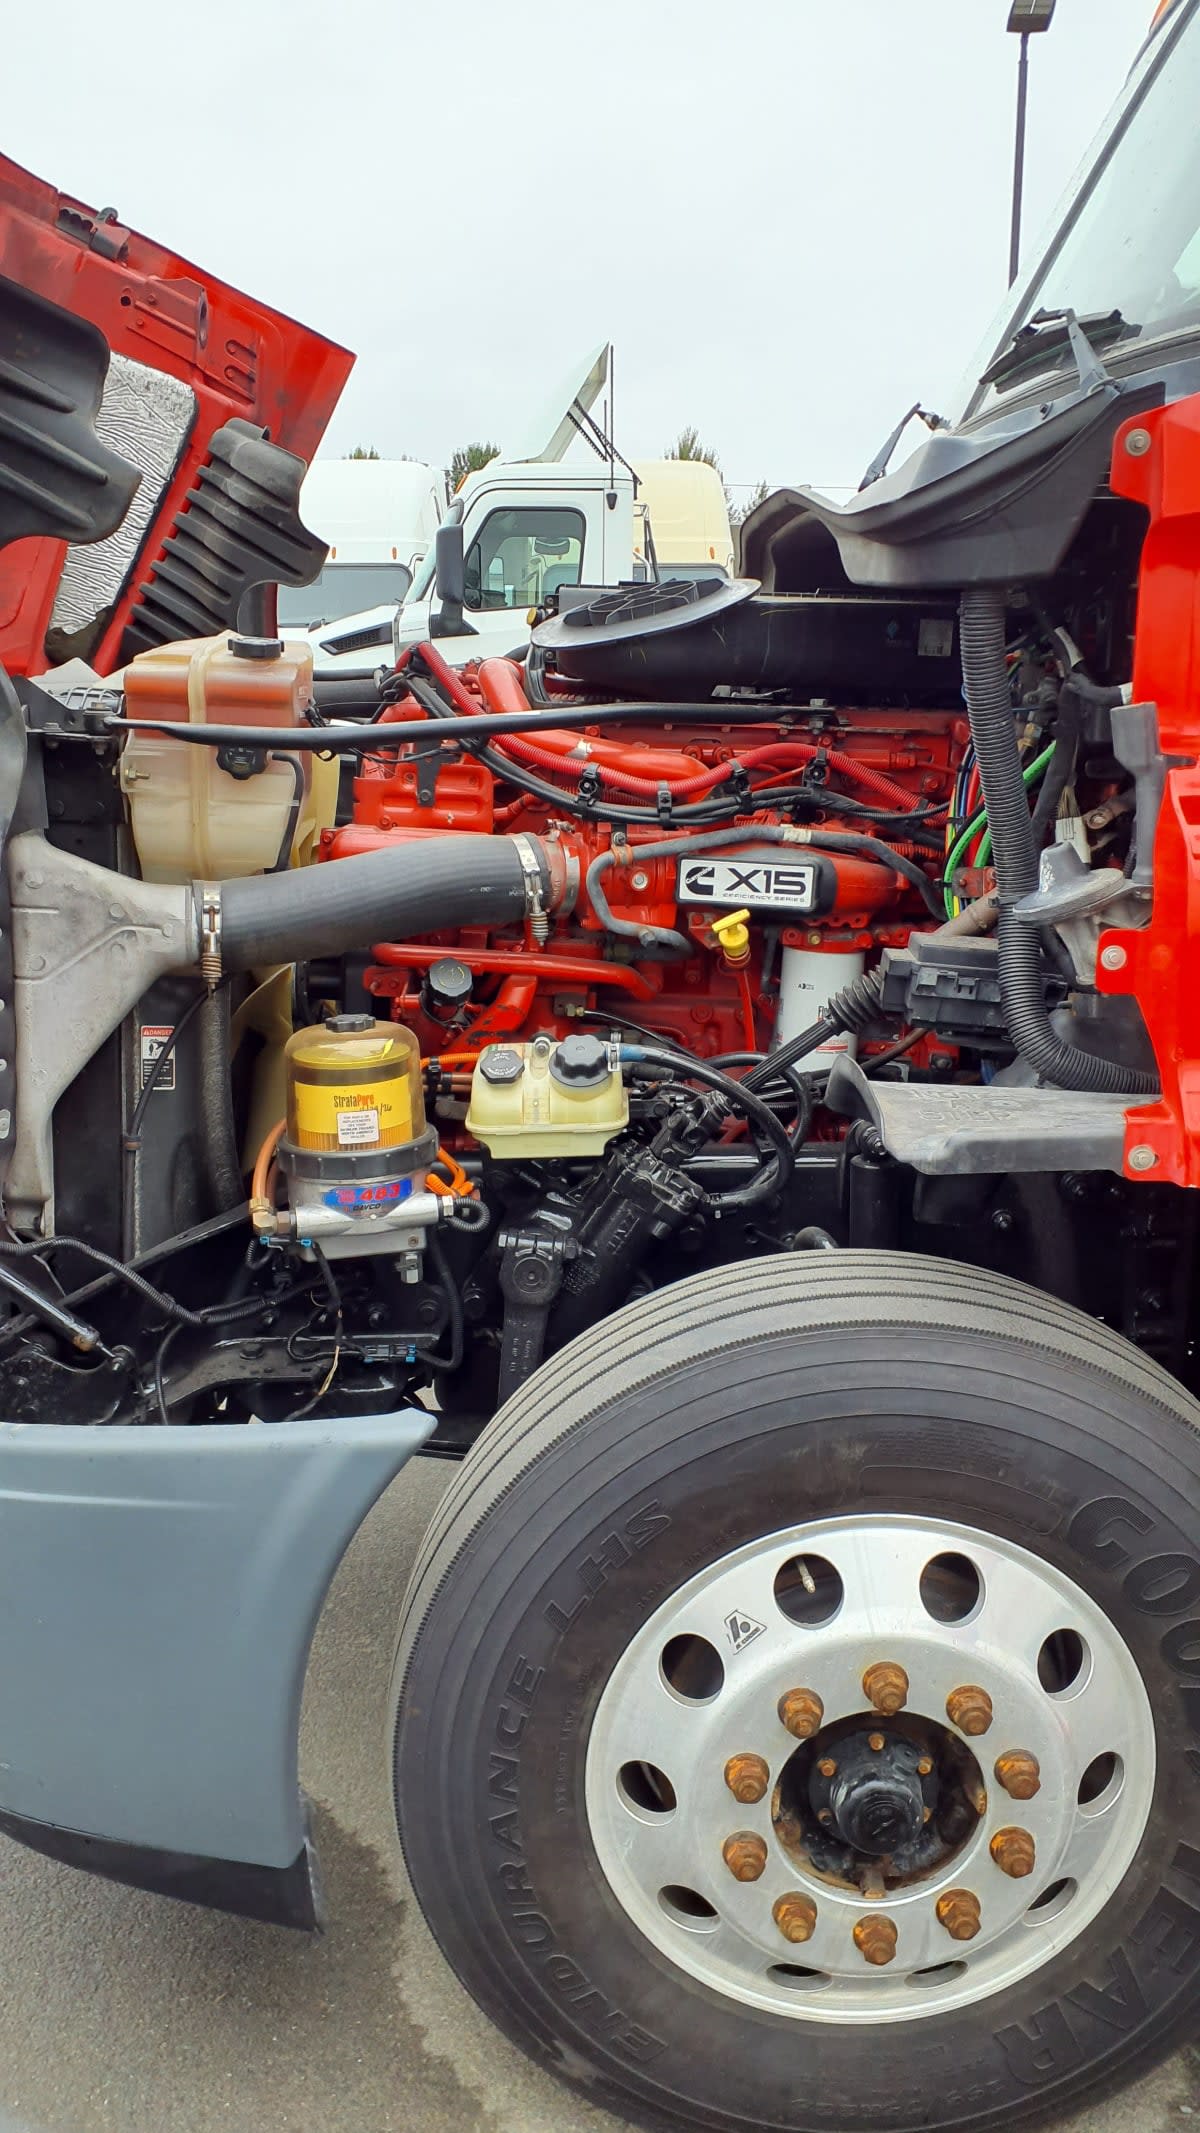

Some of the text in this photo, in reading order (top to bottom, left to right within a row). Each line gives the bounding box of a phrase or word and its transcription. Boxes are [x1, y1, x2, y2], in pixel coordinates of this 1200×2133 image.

[725, 868, 807, 895] X15
[723, 893, 772, 901] EFFICIENCY
[488, 1499, 673, 2061] ENDURANCE LHS
